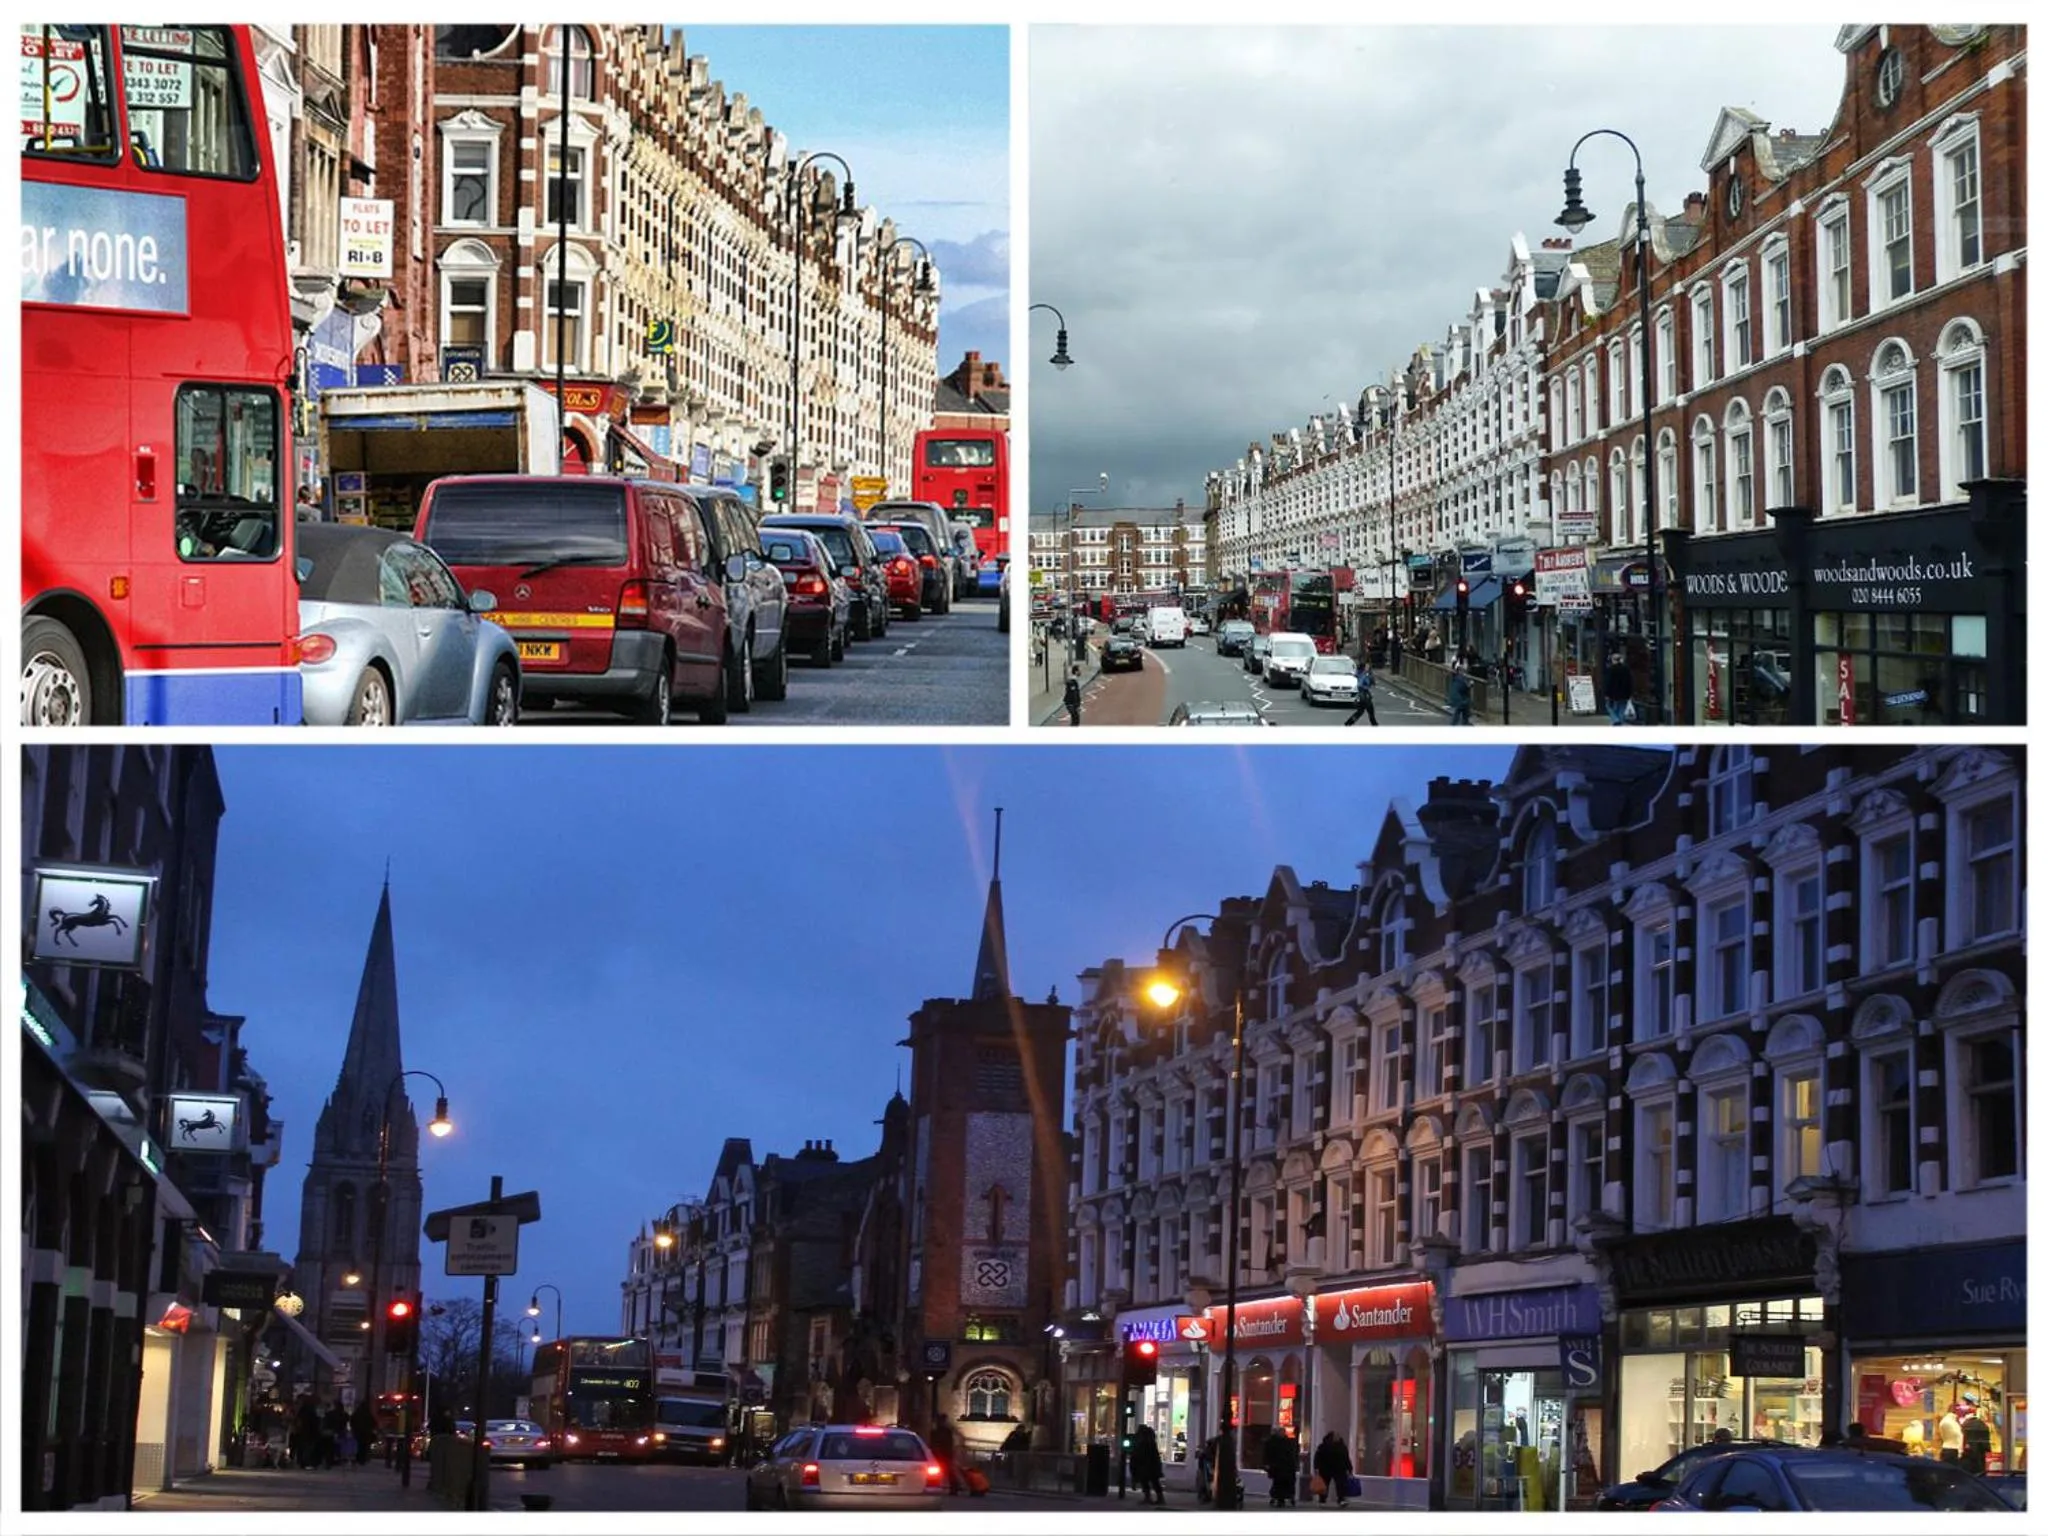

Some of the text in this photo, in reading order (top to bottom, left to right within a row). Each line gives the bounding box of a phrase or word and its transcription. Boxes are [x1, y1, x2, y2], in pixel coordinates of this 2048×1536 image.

[343, 219, 389, 234] TO LET
[21, 225, 167, 284] ar none.
[1814, 552, 1974, 583] woodsandwoods.co.uk
[1686, 574, 1725, 594] WOODS
[1727, 574, 1738, 594] &
[1852, 587, 1922, 604] 020 8444 6055
[1839, 660, 1850, 726] SAL
[1961, 1278, 1996, 1305] Sue
[1239, 1312, 1287, 1338] Santander
[1352, 1299, 1412, 1328] Santander
[1465, 1288, 1577, 1336] WHSmith
